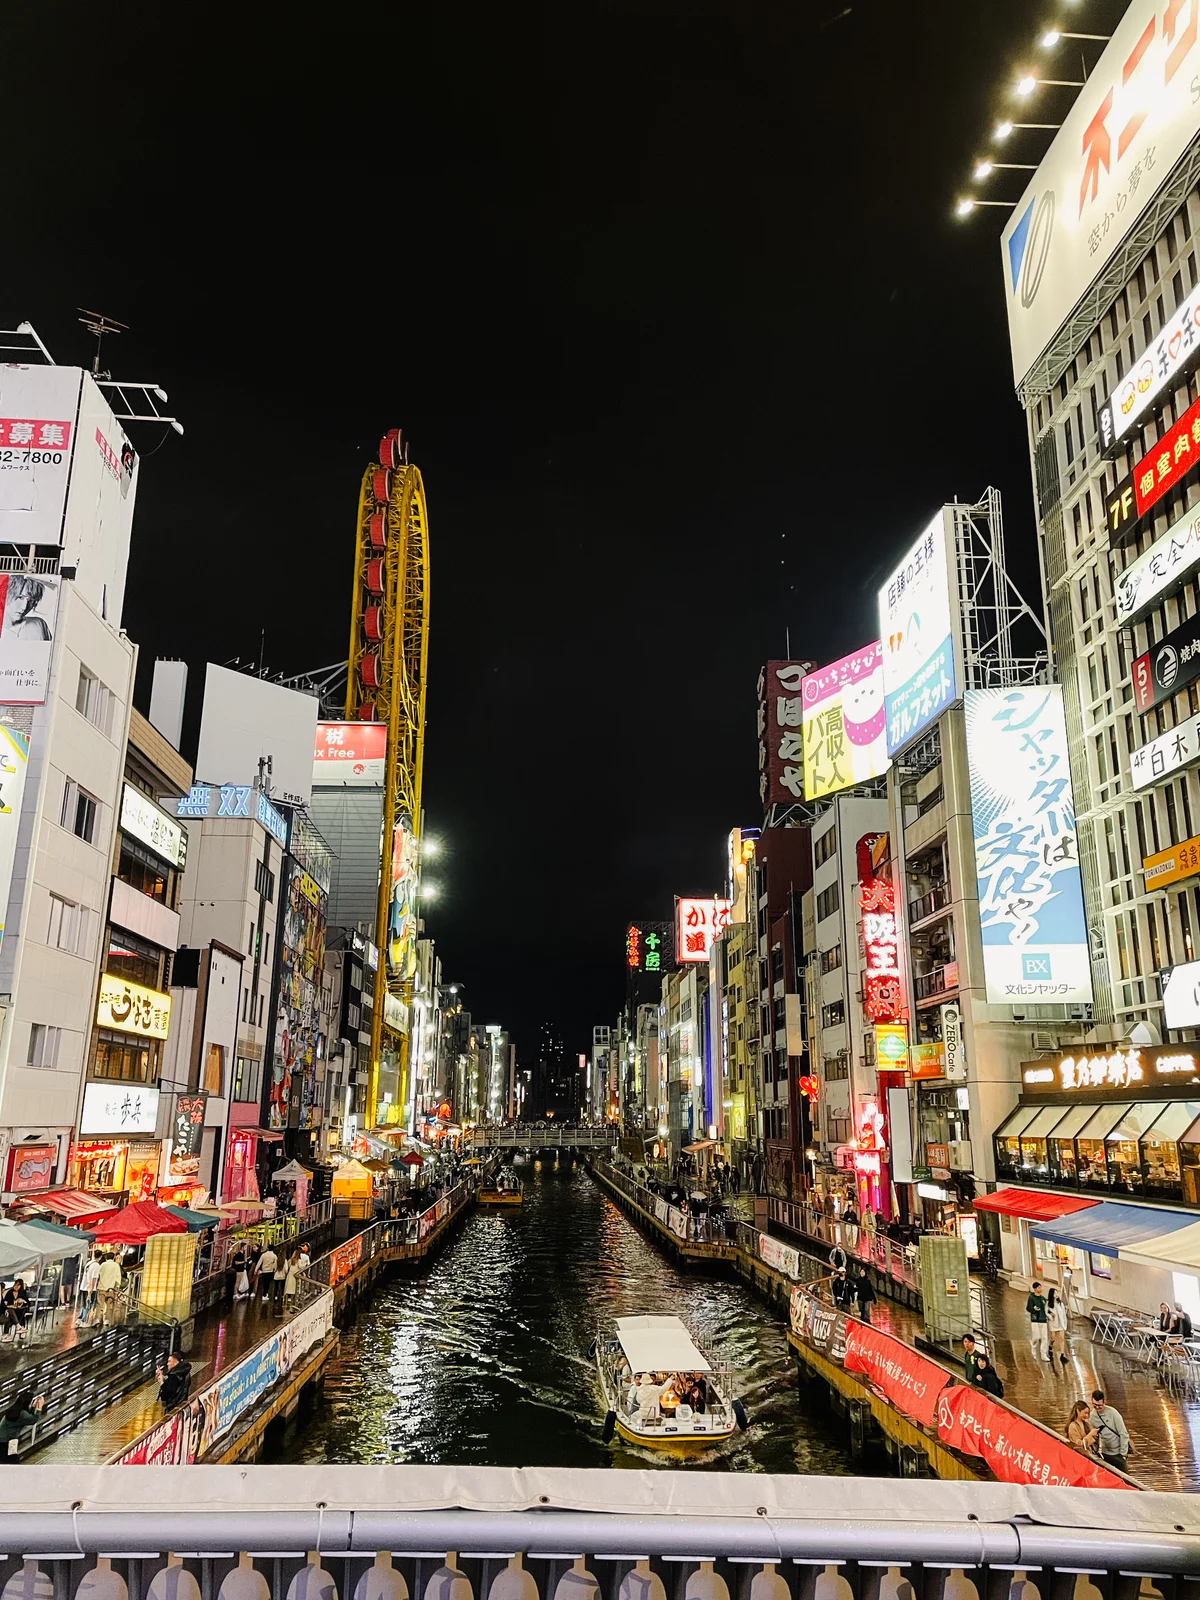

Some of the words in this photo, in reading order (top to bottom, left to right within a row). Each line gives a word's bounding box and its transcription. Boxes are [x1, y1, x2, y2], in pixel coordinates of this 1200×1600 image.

[1088, 145, 1158, 257] 窓から夢を
[1110, 486, 1133, 530] 7F
[818, 651, 875, 690] いちごなび
[1137, 661, 1148, 706] 5F
[328, 747, 355, 758] Free
[807, 712, 826, 795] バイト
[825, 705, 846, 789] 高収入
[1151, 720, 1200, 777] 白木
[645, 933, 661, 967] 千房
[686, 930, 722, 953] 道
[1026, 960, 1048, 974] BX
[946, 1025, 956, 1052] ZERO
